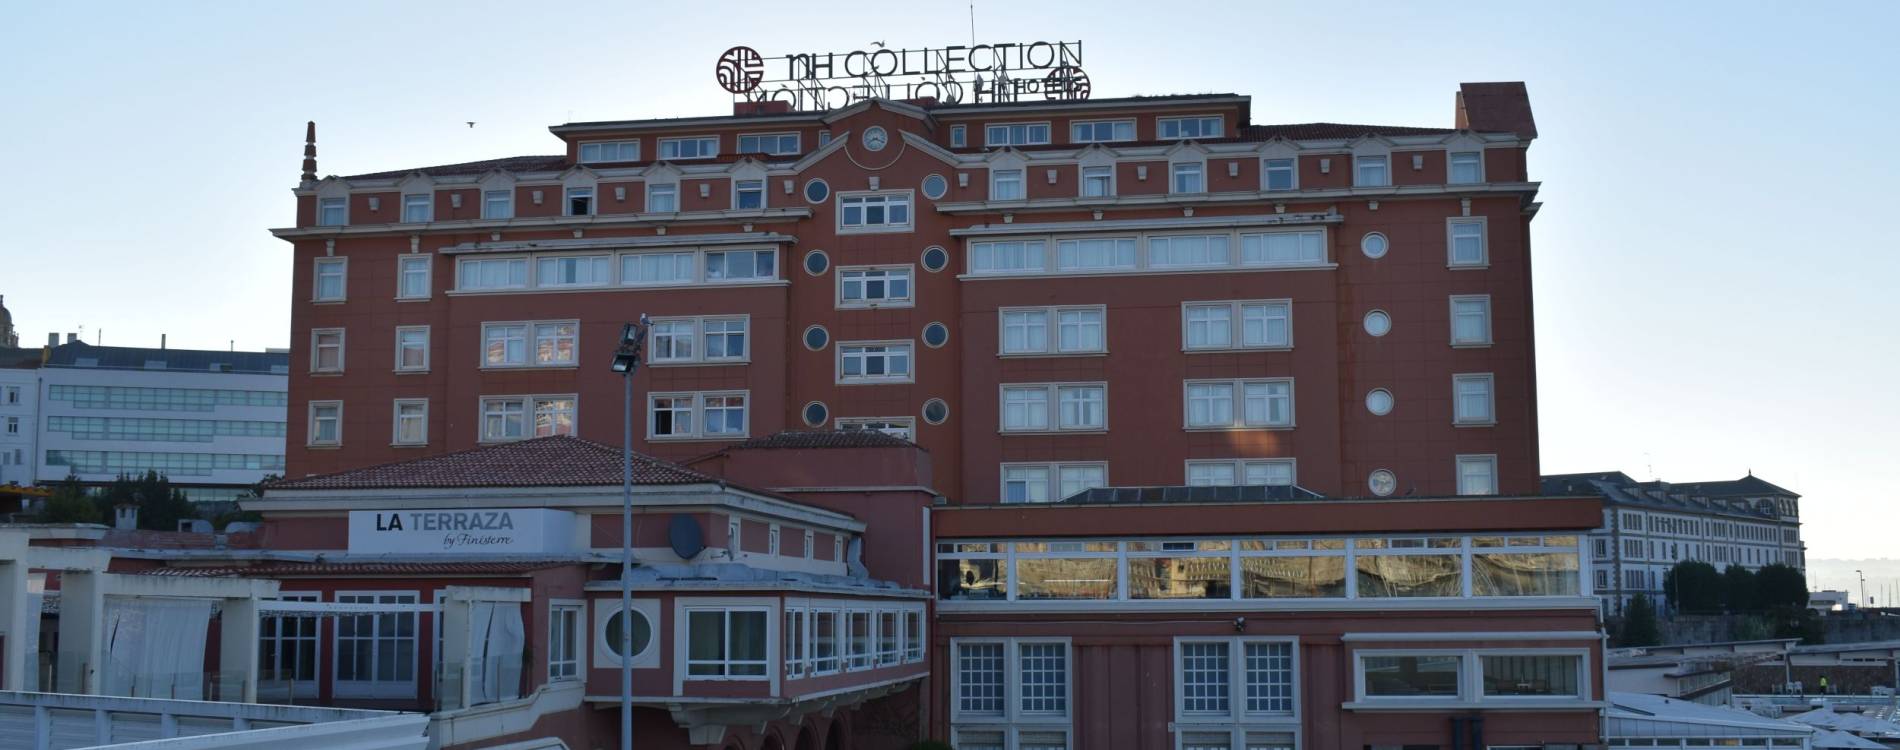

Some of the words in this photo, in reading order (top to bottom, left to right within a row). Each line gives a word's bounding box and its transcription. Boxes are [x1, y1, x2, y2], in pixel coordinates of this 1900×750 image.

[845, 40, 1082, 78] COLLECTION
[376, 513, 403, 531] LA
[410, 512, 513, 531] TERRAZA
[443, 533, 456, 550] by
[456, 533, 513, 547] Finisterre
